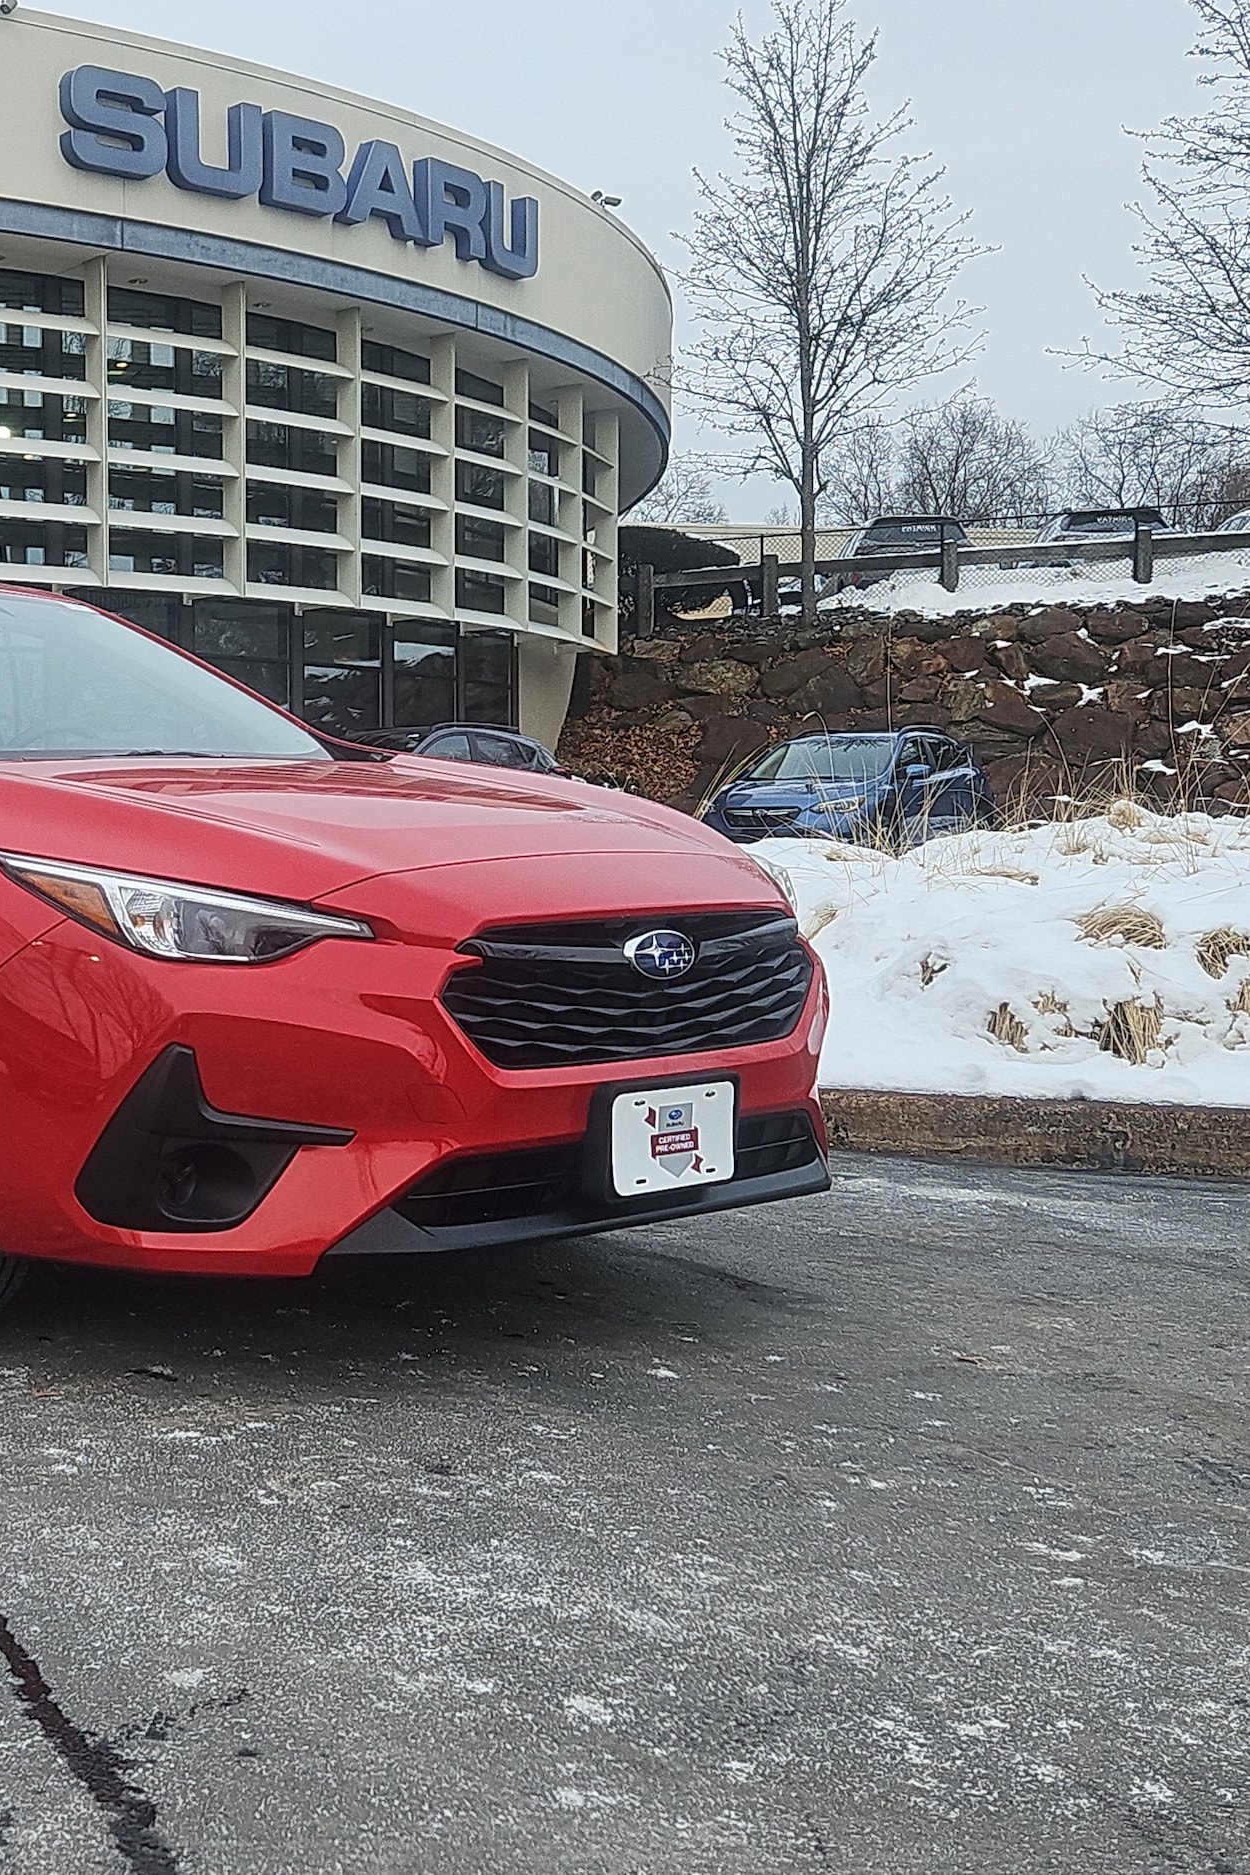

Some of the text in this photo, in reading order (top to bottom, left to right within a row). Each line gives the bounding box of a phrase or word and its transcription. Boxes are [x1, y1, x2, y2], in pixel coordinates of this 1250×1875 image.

[58, 64, 539, 280] SUBARU
[658, 1133, 691, 1144] CERTIFIED
[655, 1141, 694, 1153] PRE-OWNED
